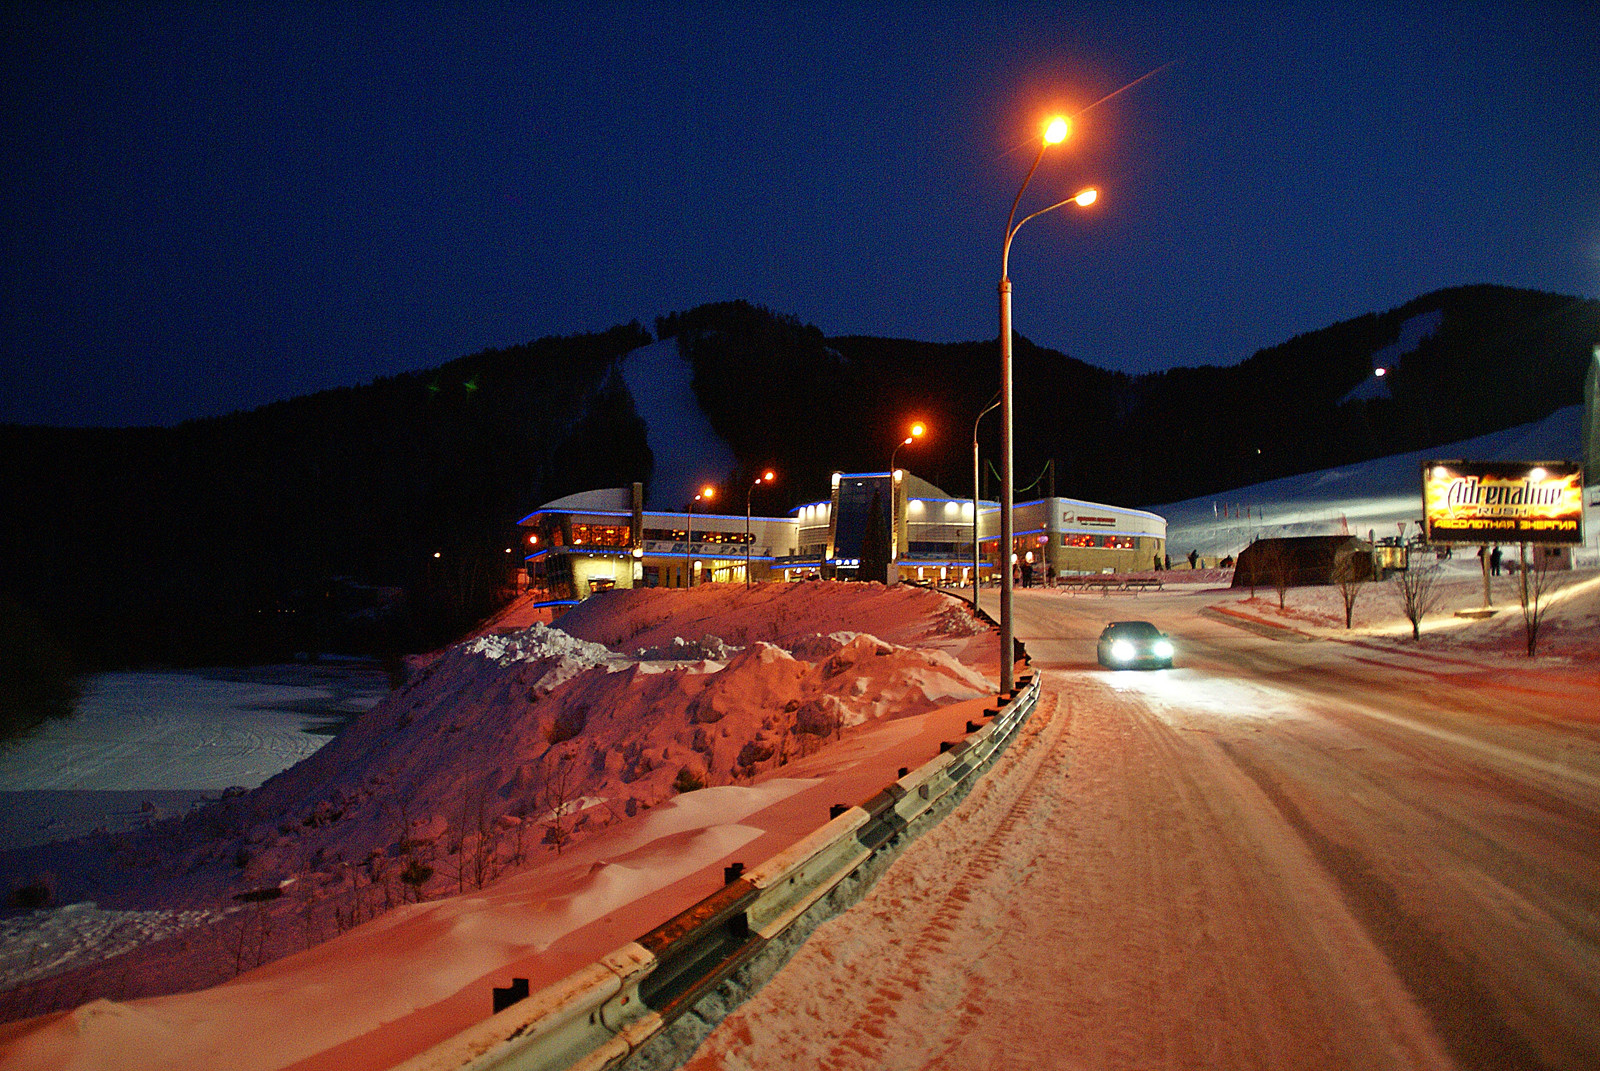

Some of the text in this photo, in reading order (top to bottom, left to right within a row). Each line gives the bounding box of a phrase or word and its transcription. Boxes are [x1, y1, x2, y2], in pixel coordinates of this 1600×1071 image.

[1447, 477, 1564, 515] Adrenaline
[1477, 507, 1530, 517] RUSH
[1434, 520, 1577, 531] АБСОЛЮТНАЯ ЭНЕРГИЯ
